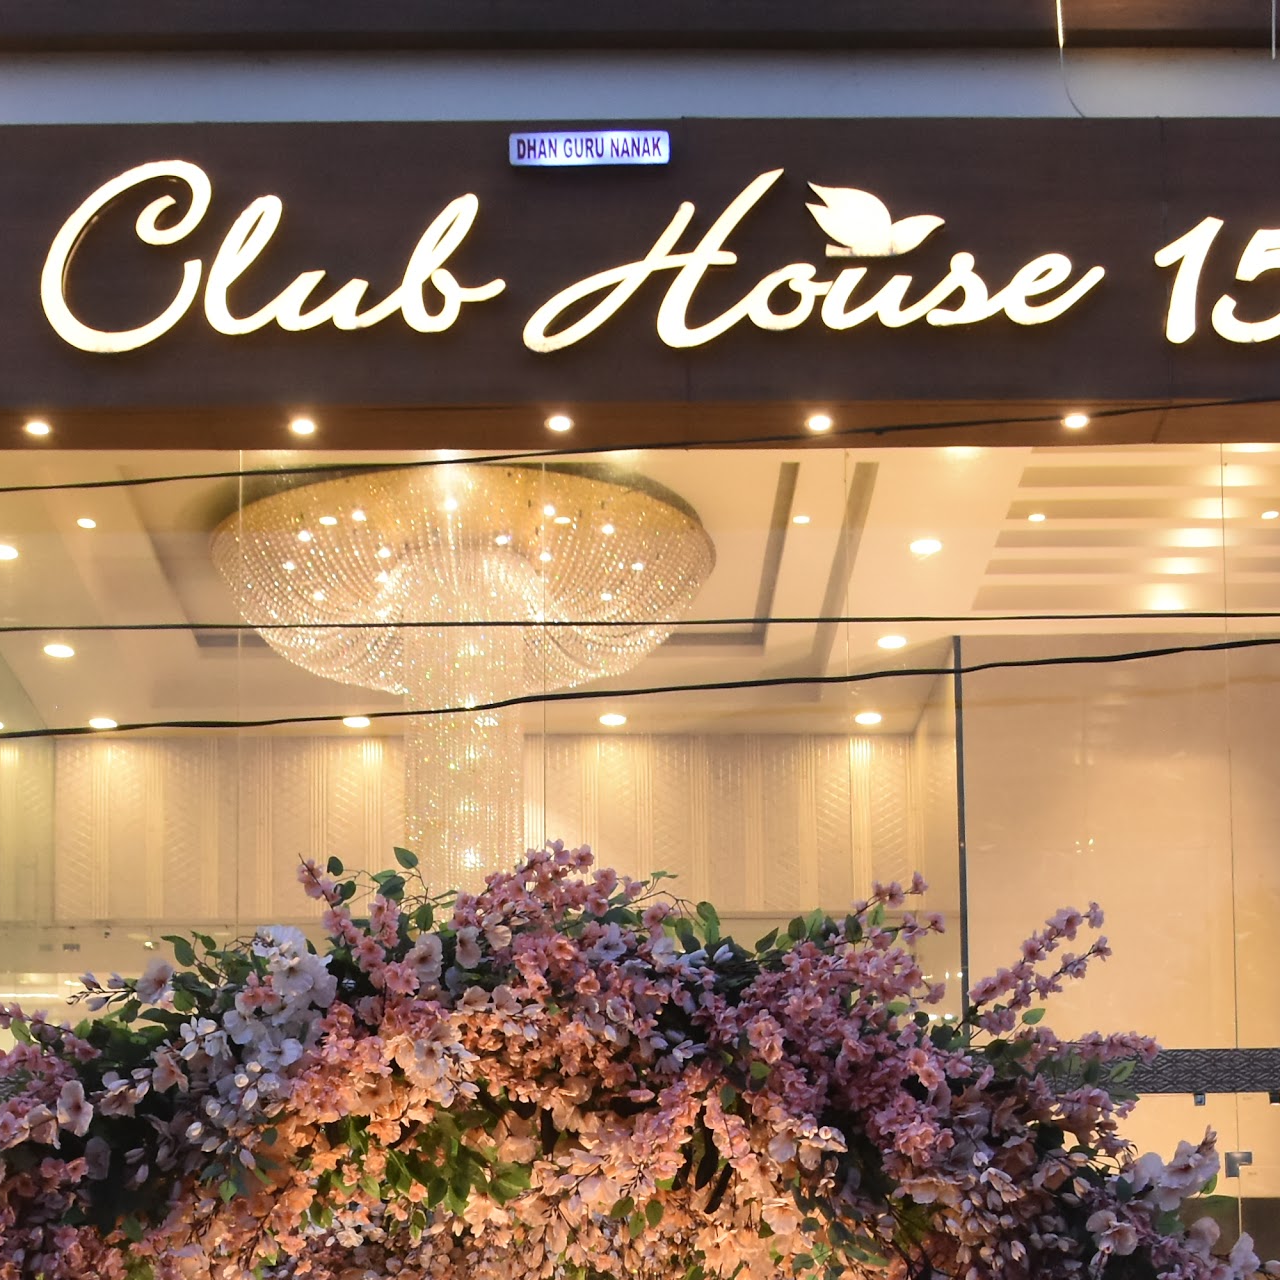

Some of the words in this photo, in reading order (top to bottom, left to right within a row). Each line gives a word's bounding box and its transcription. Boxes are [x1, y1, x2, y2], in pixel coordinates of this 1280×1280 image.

[516, 137, 558, 160] DHAN
[563, 137, 605, 158] GURU
[610, 136, 662, 157] NANAK
[40, 159, 506, 353] Club
[522, 167, 1105, 353] House
